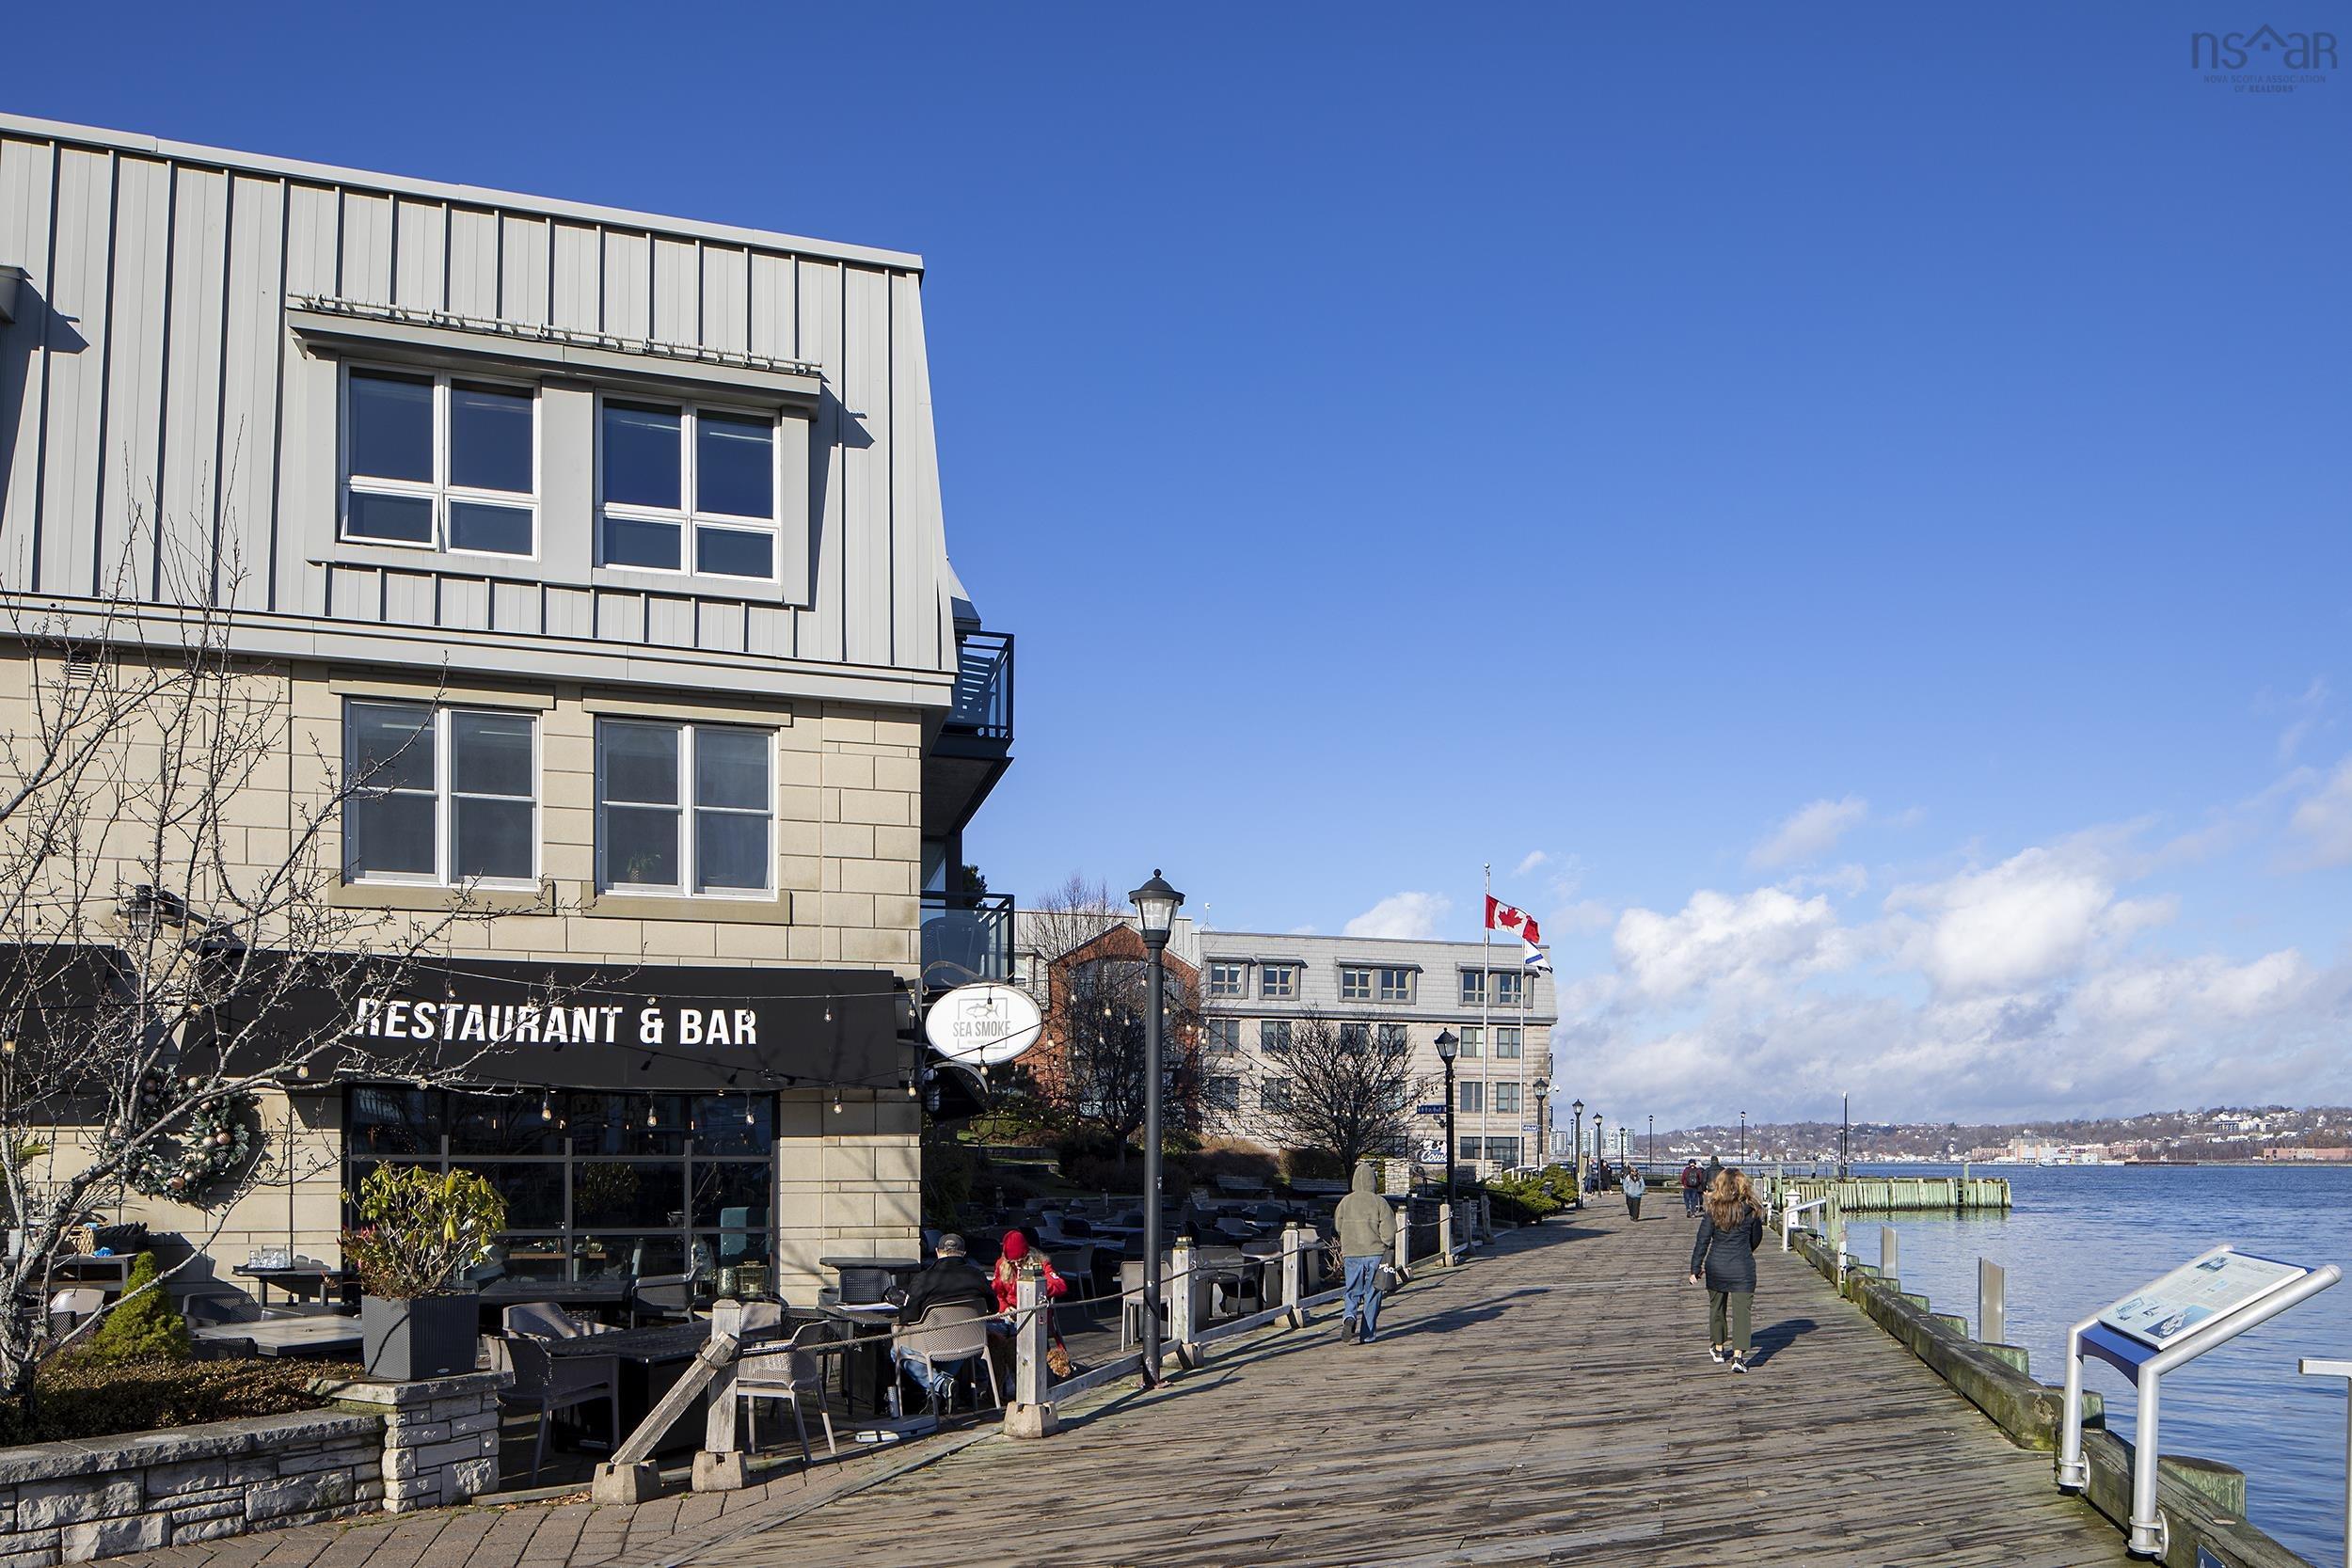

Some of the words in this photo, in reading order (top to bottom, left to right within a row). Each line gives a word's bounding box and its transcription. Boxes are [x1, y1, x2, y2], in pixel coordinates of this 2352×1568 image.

[354, 997, 623, 1044] RESTAURANT
[639, 1007, 664, 1044] &
[679, 1008, 757, 1045] BAR
[953, 1022, 972, 1037] SEA
[975, 1021, 1010, 1037] SMOKE
